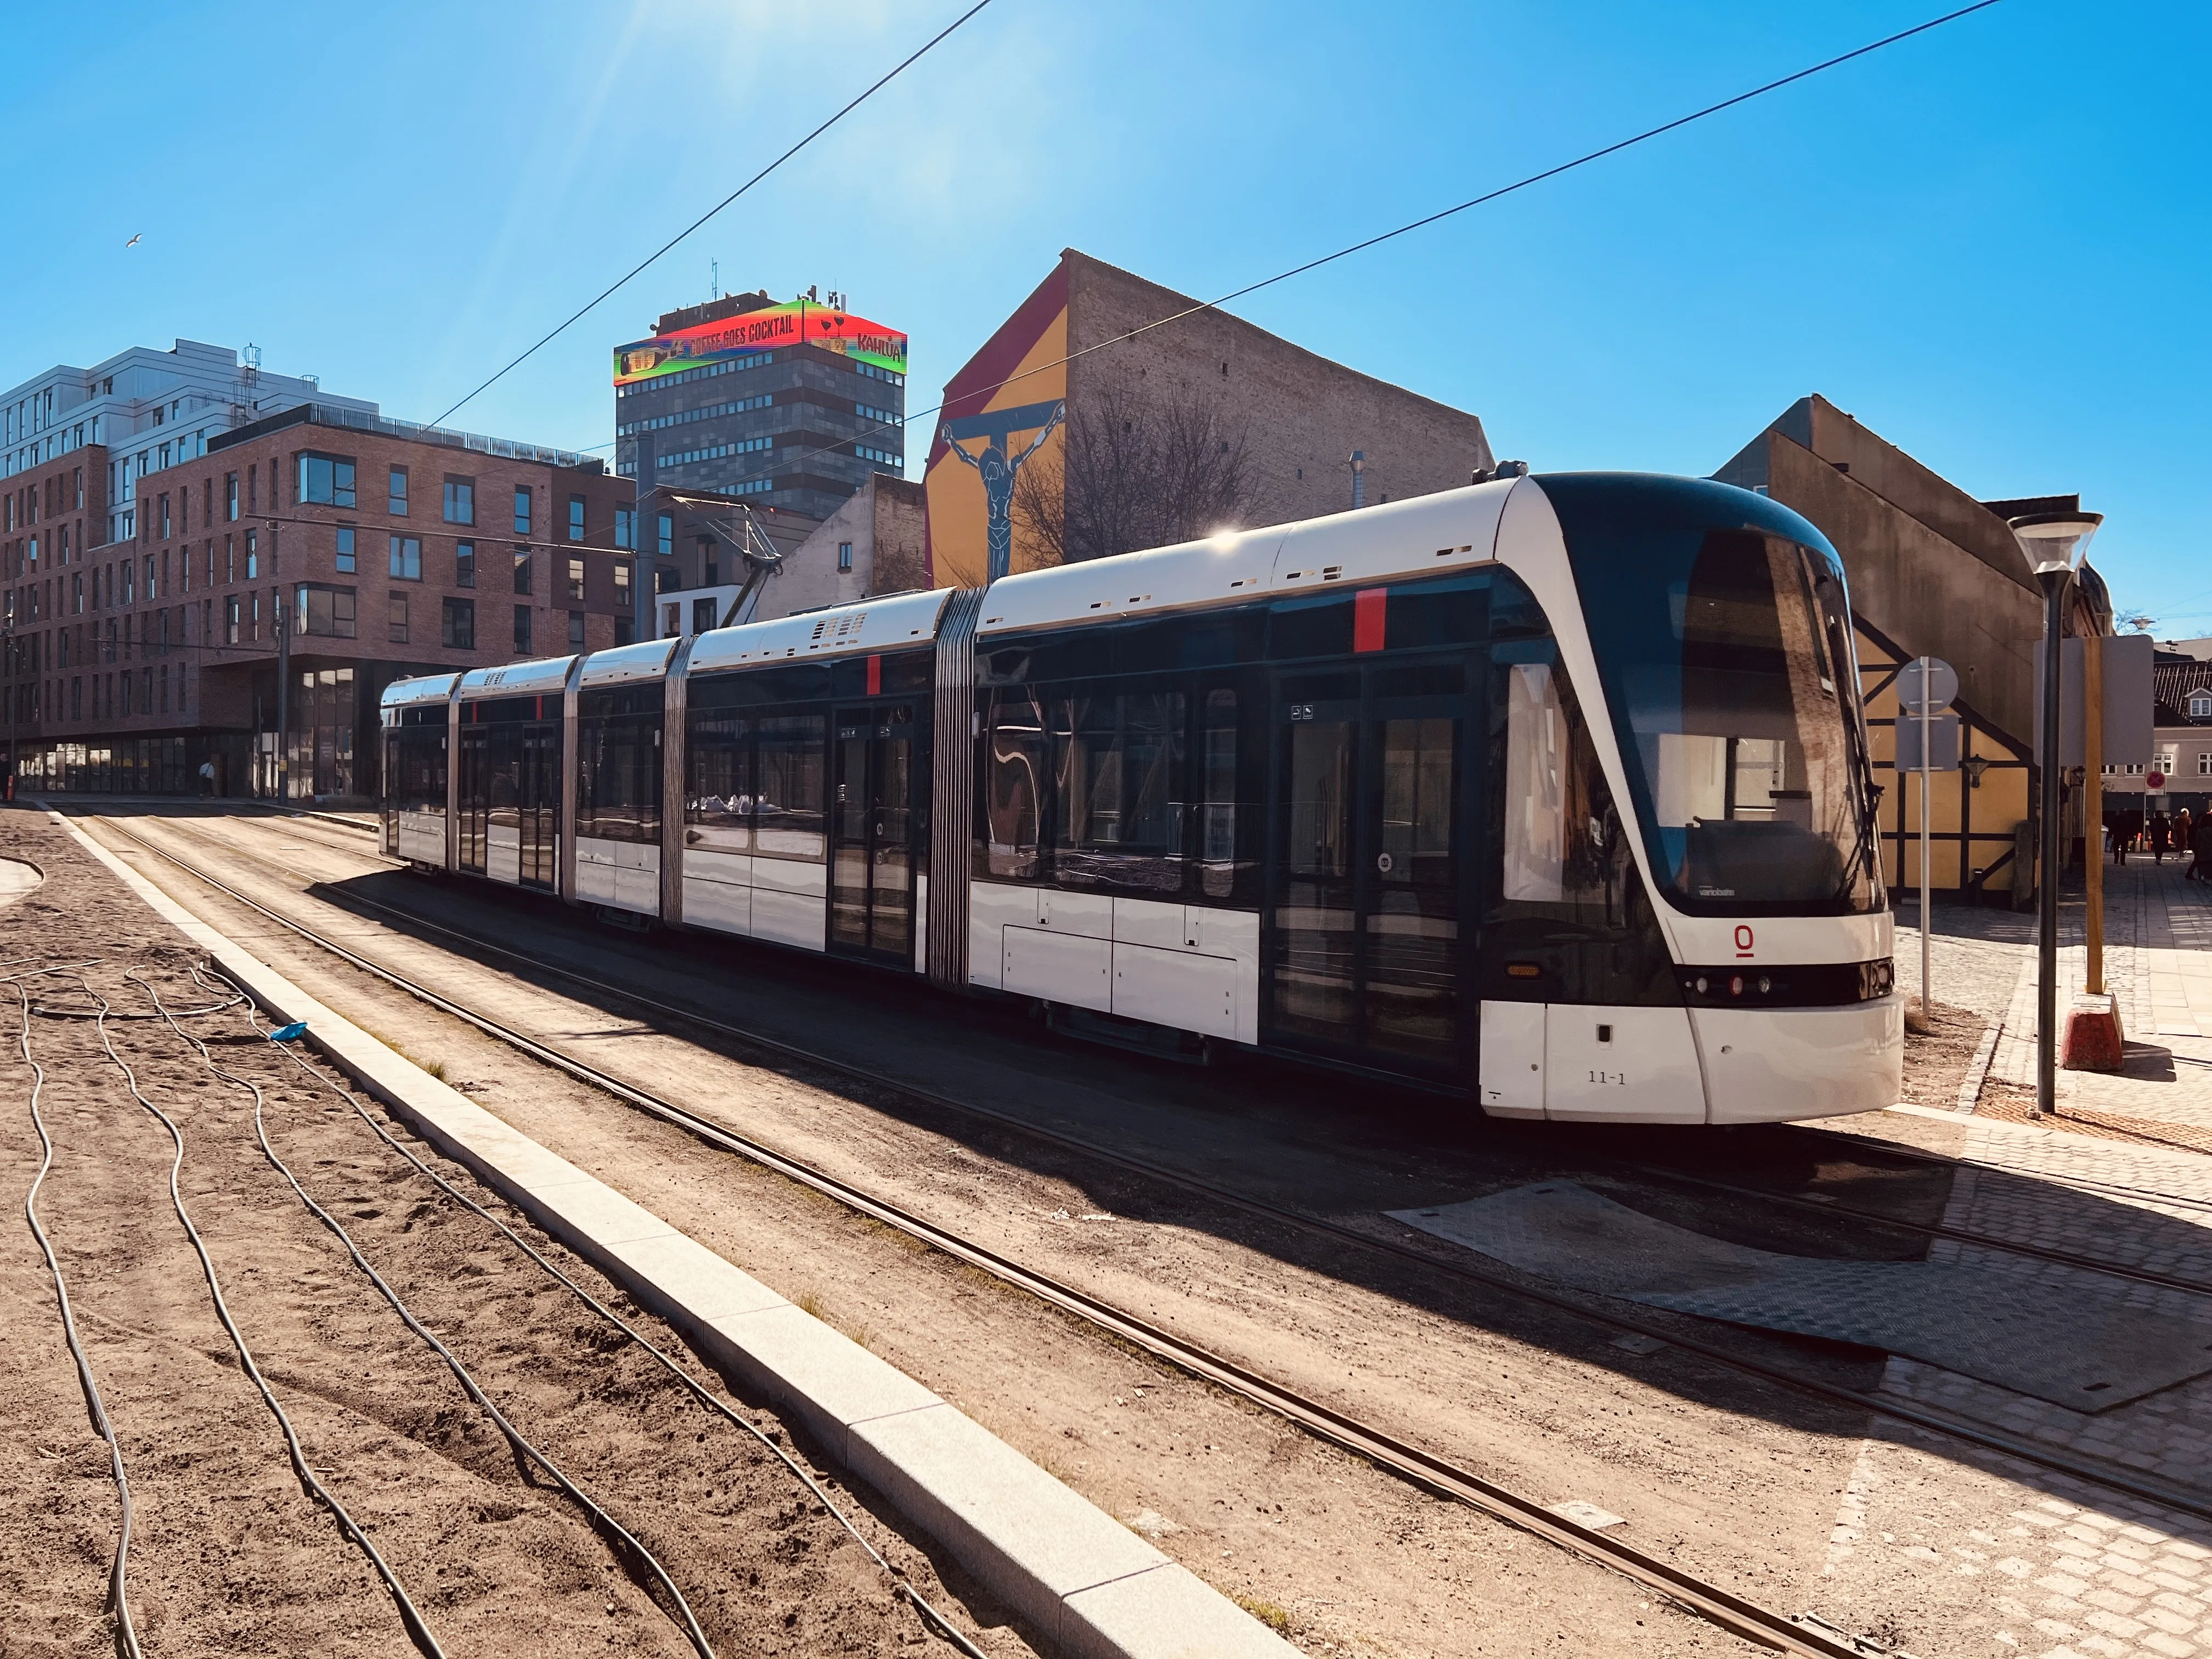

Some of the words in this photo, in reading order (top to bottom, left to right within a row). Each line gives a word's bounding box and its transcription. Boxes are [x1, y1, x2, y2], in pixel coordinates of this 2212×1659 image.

[691, 332, 721, 356] COFFEE
[724, 326, 746, 348] GOES
[748, 314, 794, 342] COCKTAIL
[1589, 1071, 1626, 1085] 11-1
